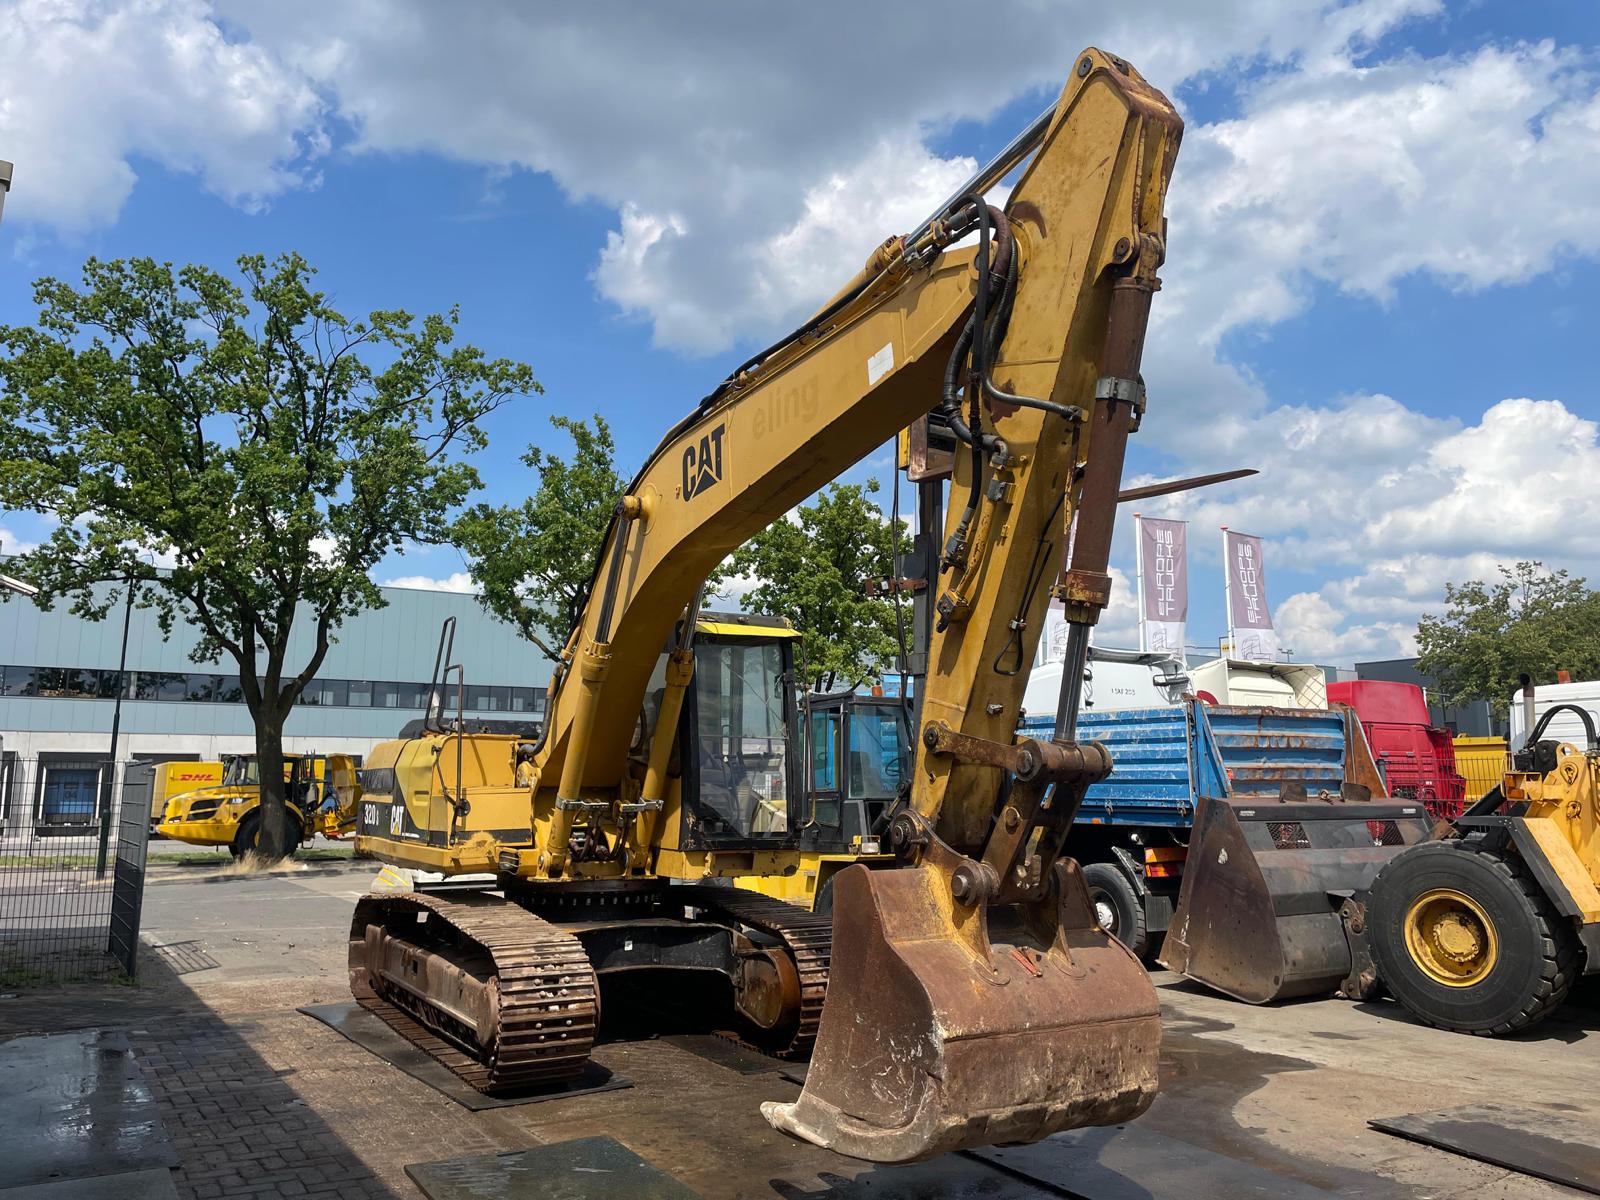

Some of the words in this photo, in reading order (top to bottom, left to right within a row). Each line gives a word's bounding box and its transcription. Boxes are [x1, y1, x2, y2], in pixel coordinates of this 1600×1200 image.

[682, 422, 725, 502] CAT
[1156, 529, 1165, 616] EUROPE
[1165, 530, 1175, 616] TRUCKS
[1237, 543, 1256, 623] EUROPE
[1244, 543, 1262, 623] TRUCKS
[390, 804, 405, 836] CAT
